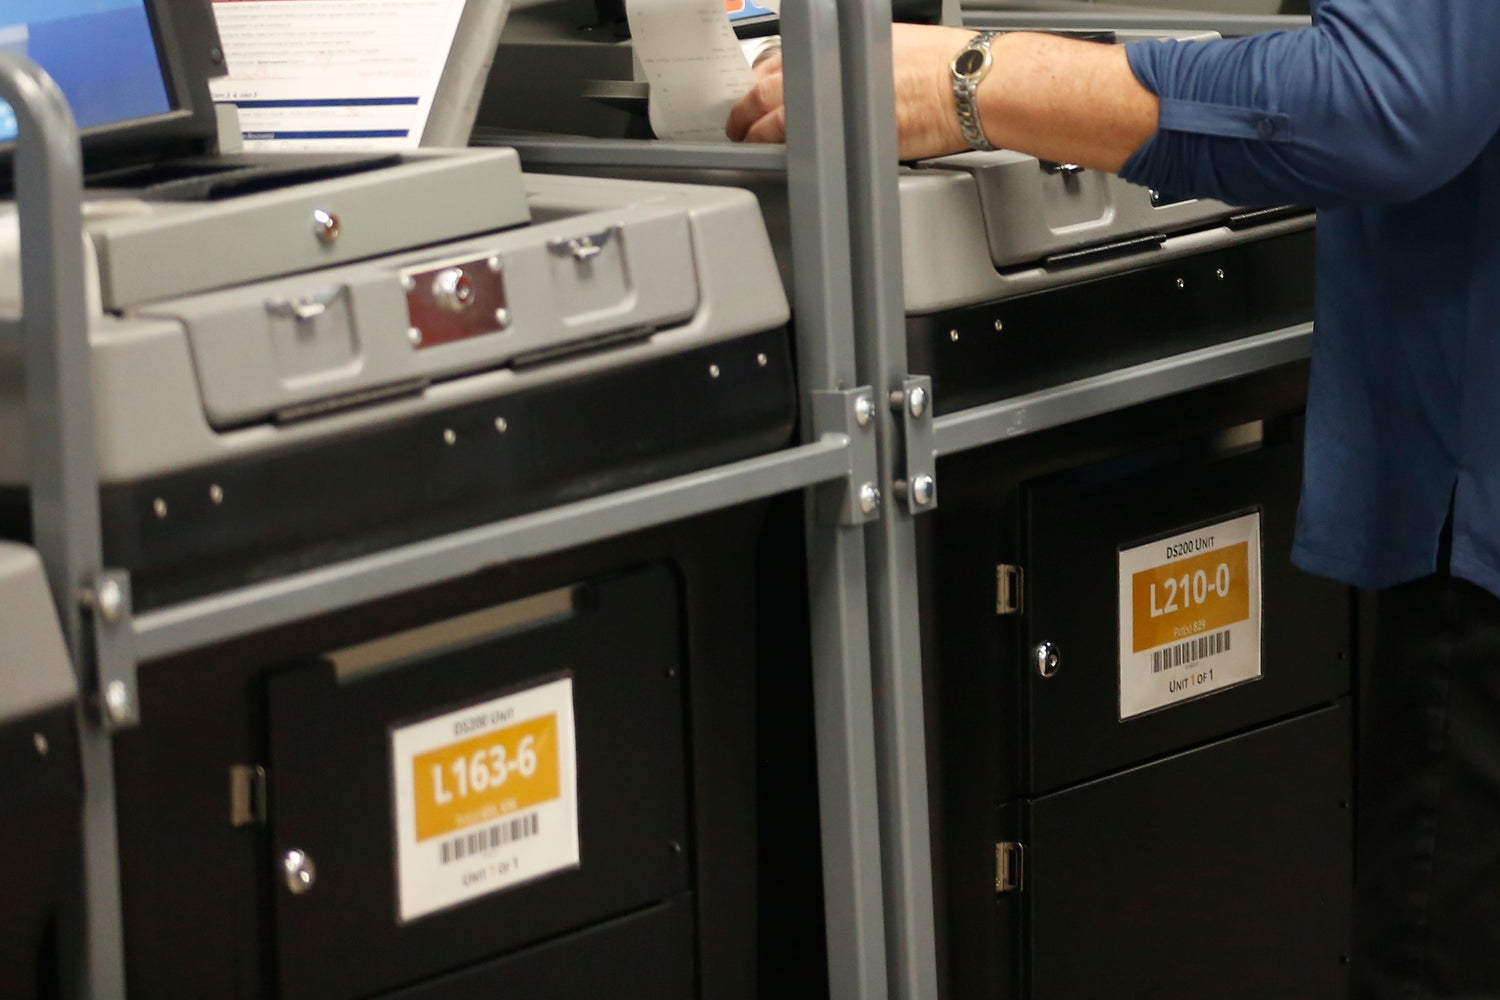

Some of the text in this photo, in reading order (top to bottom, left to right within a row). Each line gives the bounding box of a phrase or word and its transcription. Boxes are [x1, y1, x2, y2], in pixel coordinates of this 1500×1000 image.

[1166, 540, 1193, 559] DS200
[1150, 563, 1230, 618] L210-0
[1190, 673, 1195, 686] 1
[1209, 668, 1213, 681] 1
[432, 735, 537, 804] L163-6
